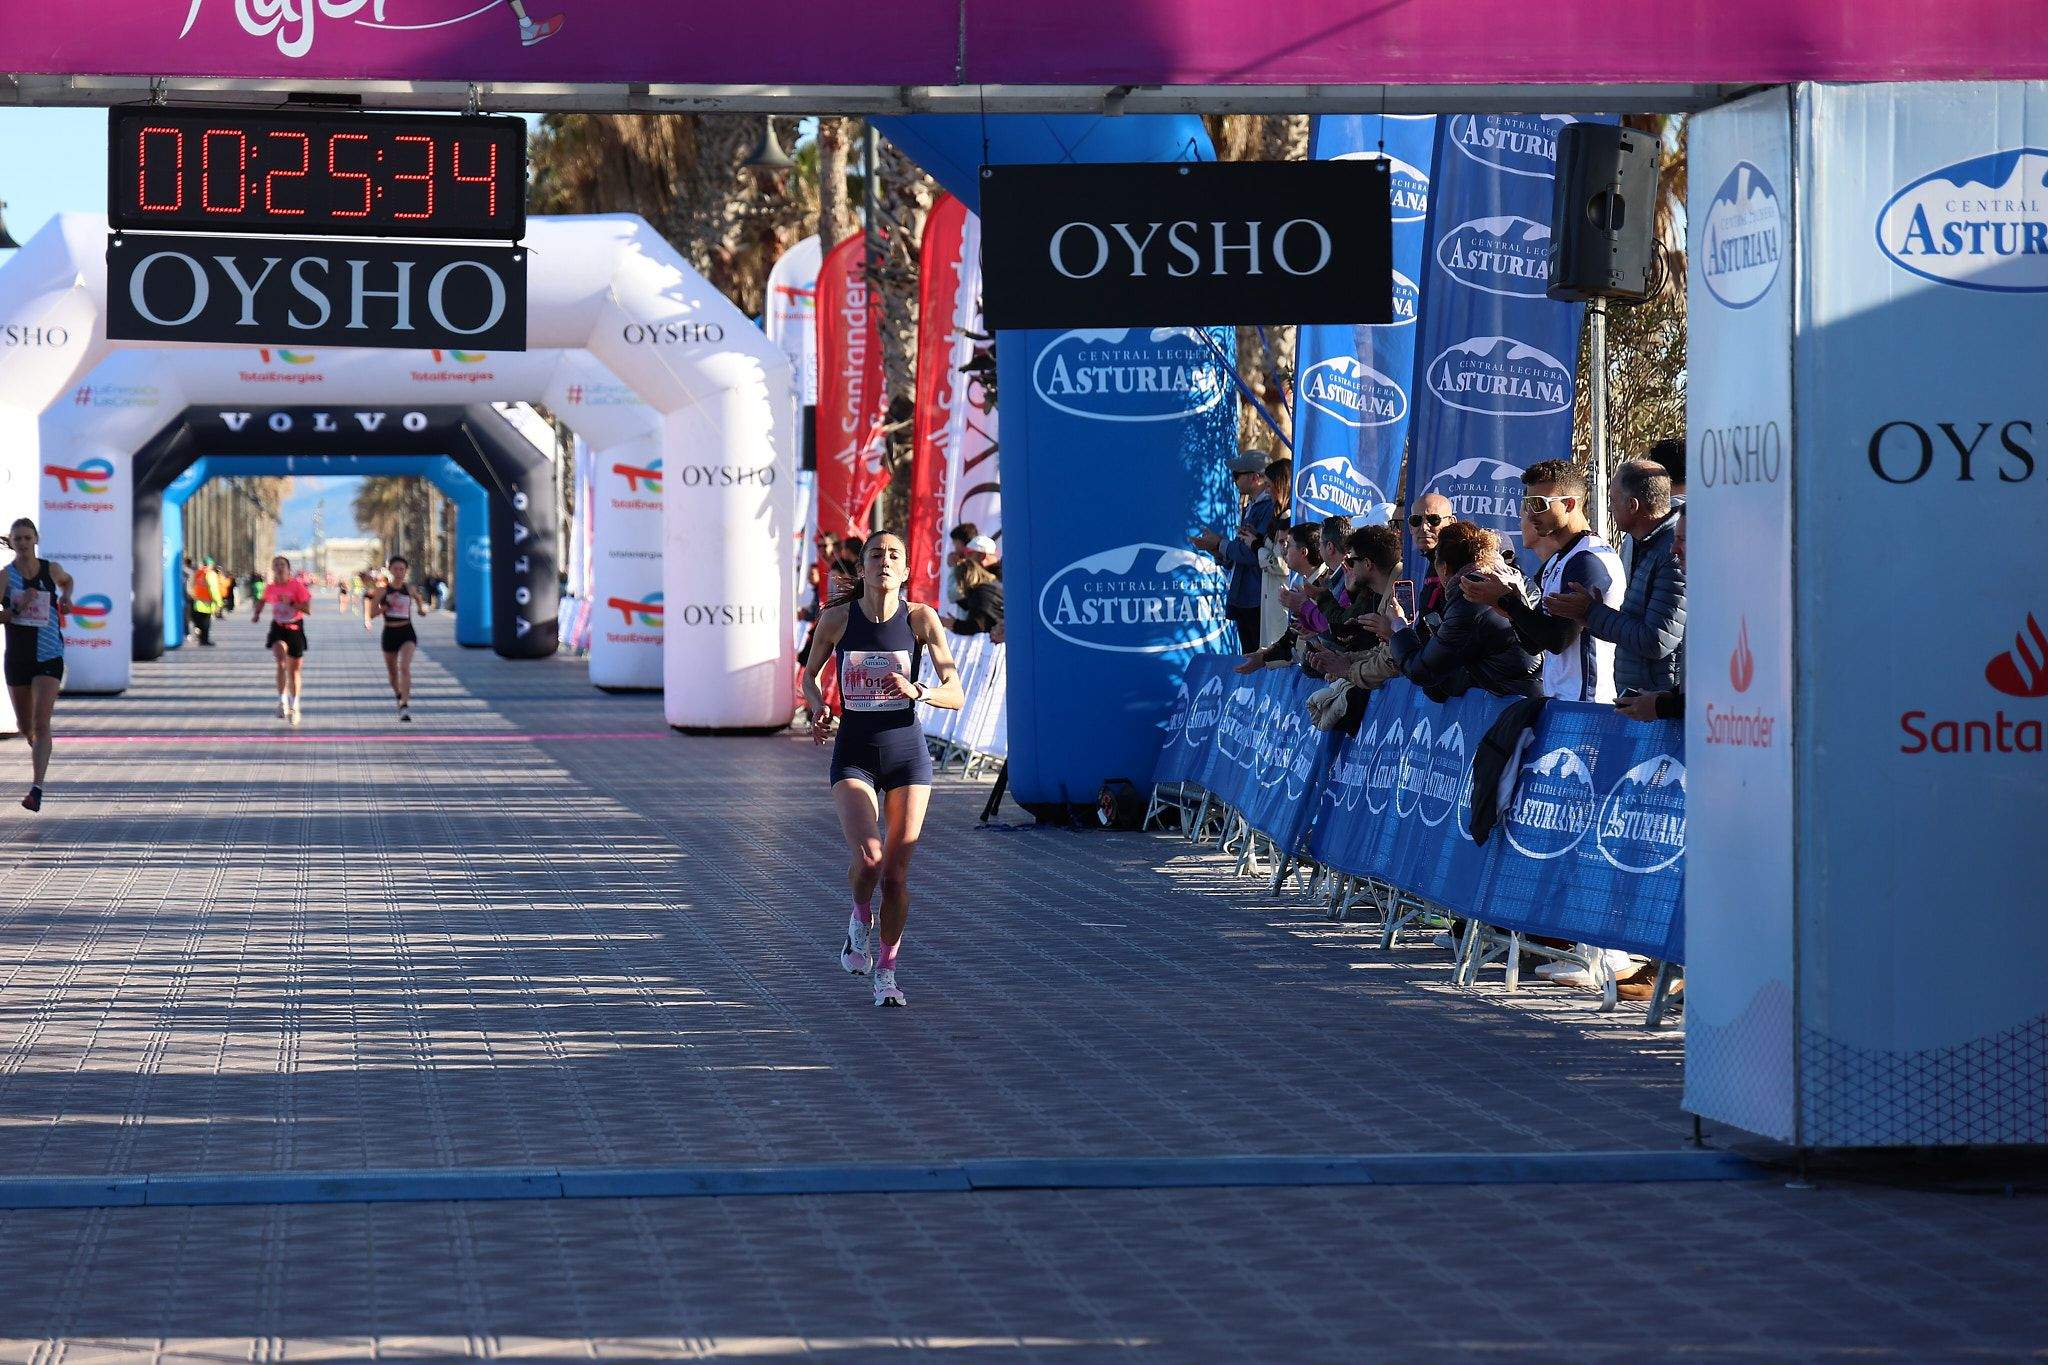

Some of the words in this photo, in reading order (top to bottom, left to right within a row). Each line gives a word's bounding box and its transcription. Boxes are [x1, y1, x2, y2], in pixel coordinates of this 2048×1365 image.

[1461, 114, 1556, 161] ASTURIA
[1487, 115, 1538, 131] CENTRAL
[139, 127, 497, 218] 00:25:34
[1391, 178, 1428, 192] ECHERA
[1945, 199, 2040, 213] CENTRAL
[1049, 218, 1332, 279] OYSHO
[1471, 237, 1521, 253] CENTRAL
[1707, 224, 1779, 276] ASTURIANA
[1898, 202, 2048, 256] ASTUR
[1448, 237, 1549, 279] ASTURIA
[128, 251, 506, 335] OYSHO
[623, 322, 724, 345] OYSHO
[841, 272, 867, 433] Santander
[1047, 354, 1220, 395] ASTURIANA
[1078, 350, 1150, 361] CENTRAL
[1510, 363, 1563, 380] LECHERA
[1307, 373, 1396, 417] ASTURIANA
[1437, 361, 1565, 404] ASTURIANA
[219, 412, 428, 432] VOLVO
[1701, 421, 1780, 488] OYSHO
[1868, 421, 2048, 485] OYS
[682, 464, 776, 487] OYSHO
[1494, 485, 1525, 496] LECH
[512, 490, 531, 639] VOLVO
[1053, 584, 1226, 624] ASTURIANA
[1084, 581, 1156, 592] CENTRAL
[1706, 703, 1775, 748] Santander
[1899, 711, 2043, 753] Santa
[1601, 795, 1687, 847] ASTURIANA
